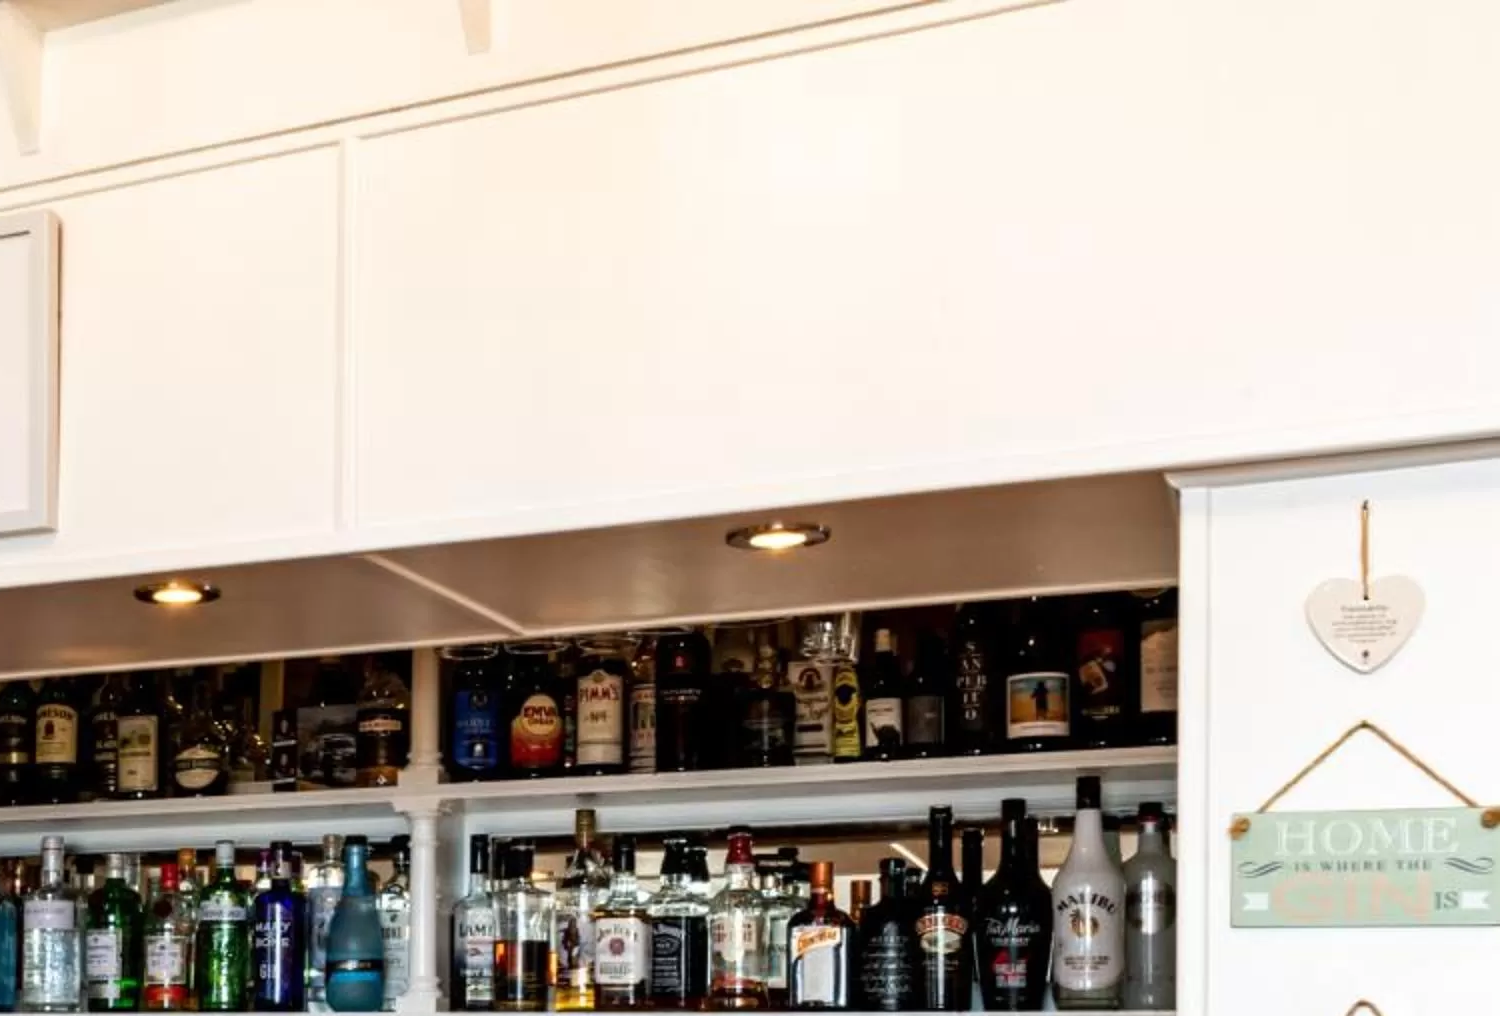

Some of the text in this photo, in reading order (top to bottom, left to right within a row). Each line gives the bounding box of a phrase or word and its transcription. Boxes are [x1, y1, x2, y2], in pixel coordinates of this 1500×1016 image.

[1274, 816, 1460, 857] HOME
[1294, 859, 1433, 873] IS WHERE THE
[1272, 871, 1459, 923] GIN IS
